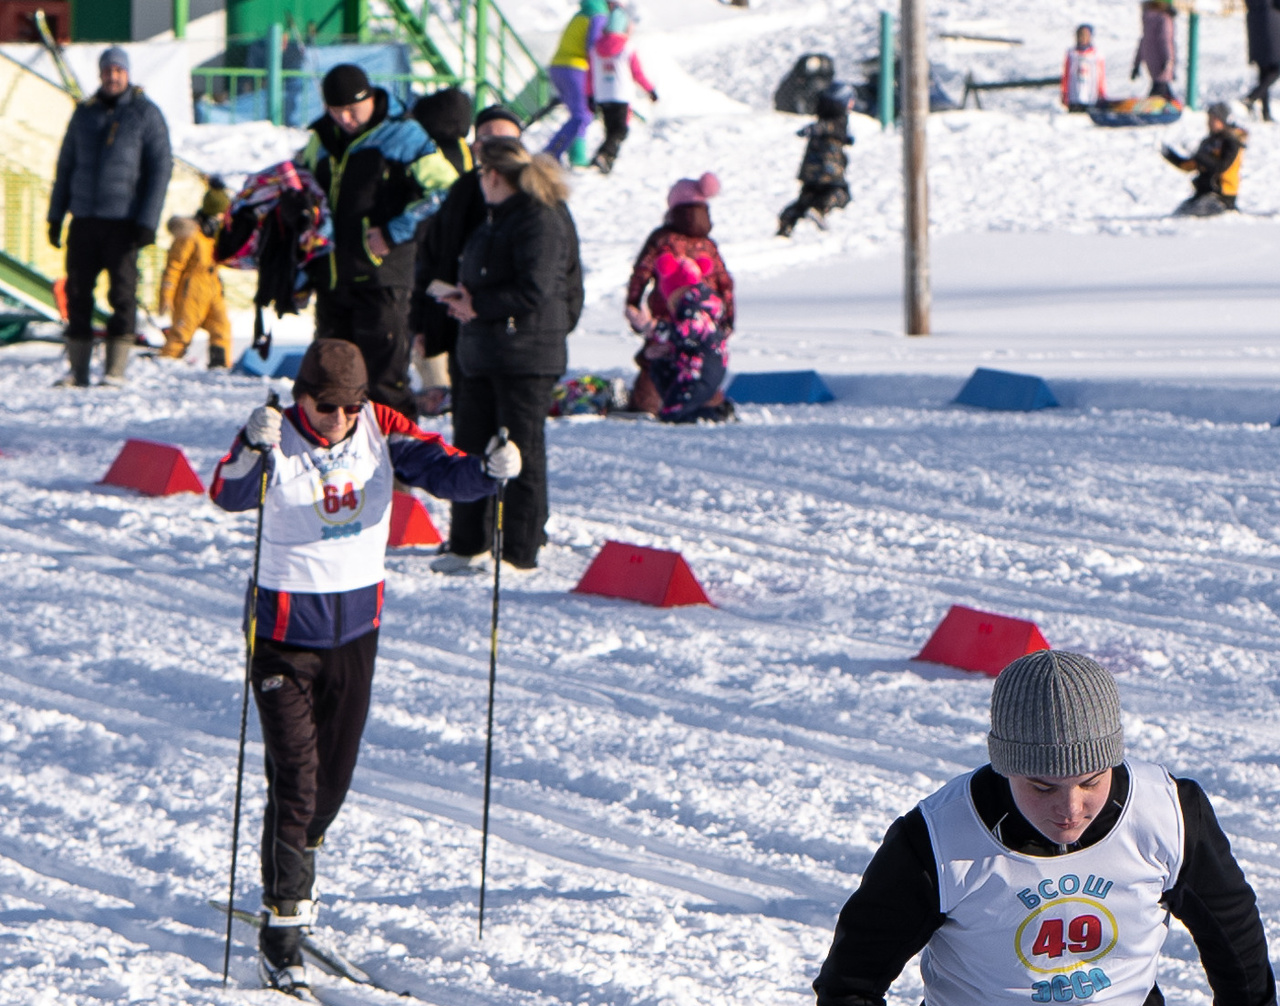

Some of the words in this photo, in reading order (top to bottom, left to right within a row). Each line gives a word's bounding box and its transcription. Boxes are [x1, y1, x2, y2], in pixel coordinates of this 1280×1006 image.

[324, 482, 357, 514] 64
[1017, 874, 1113, 909] БСОШ
[1032, 914, 1102, 958] 49
